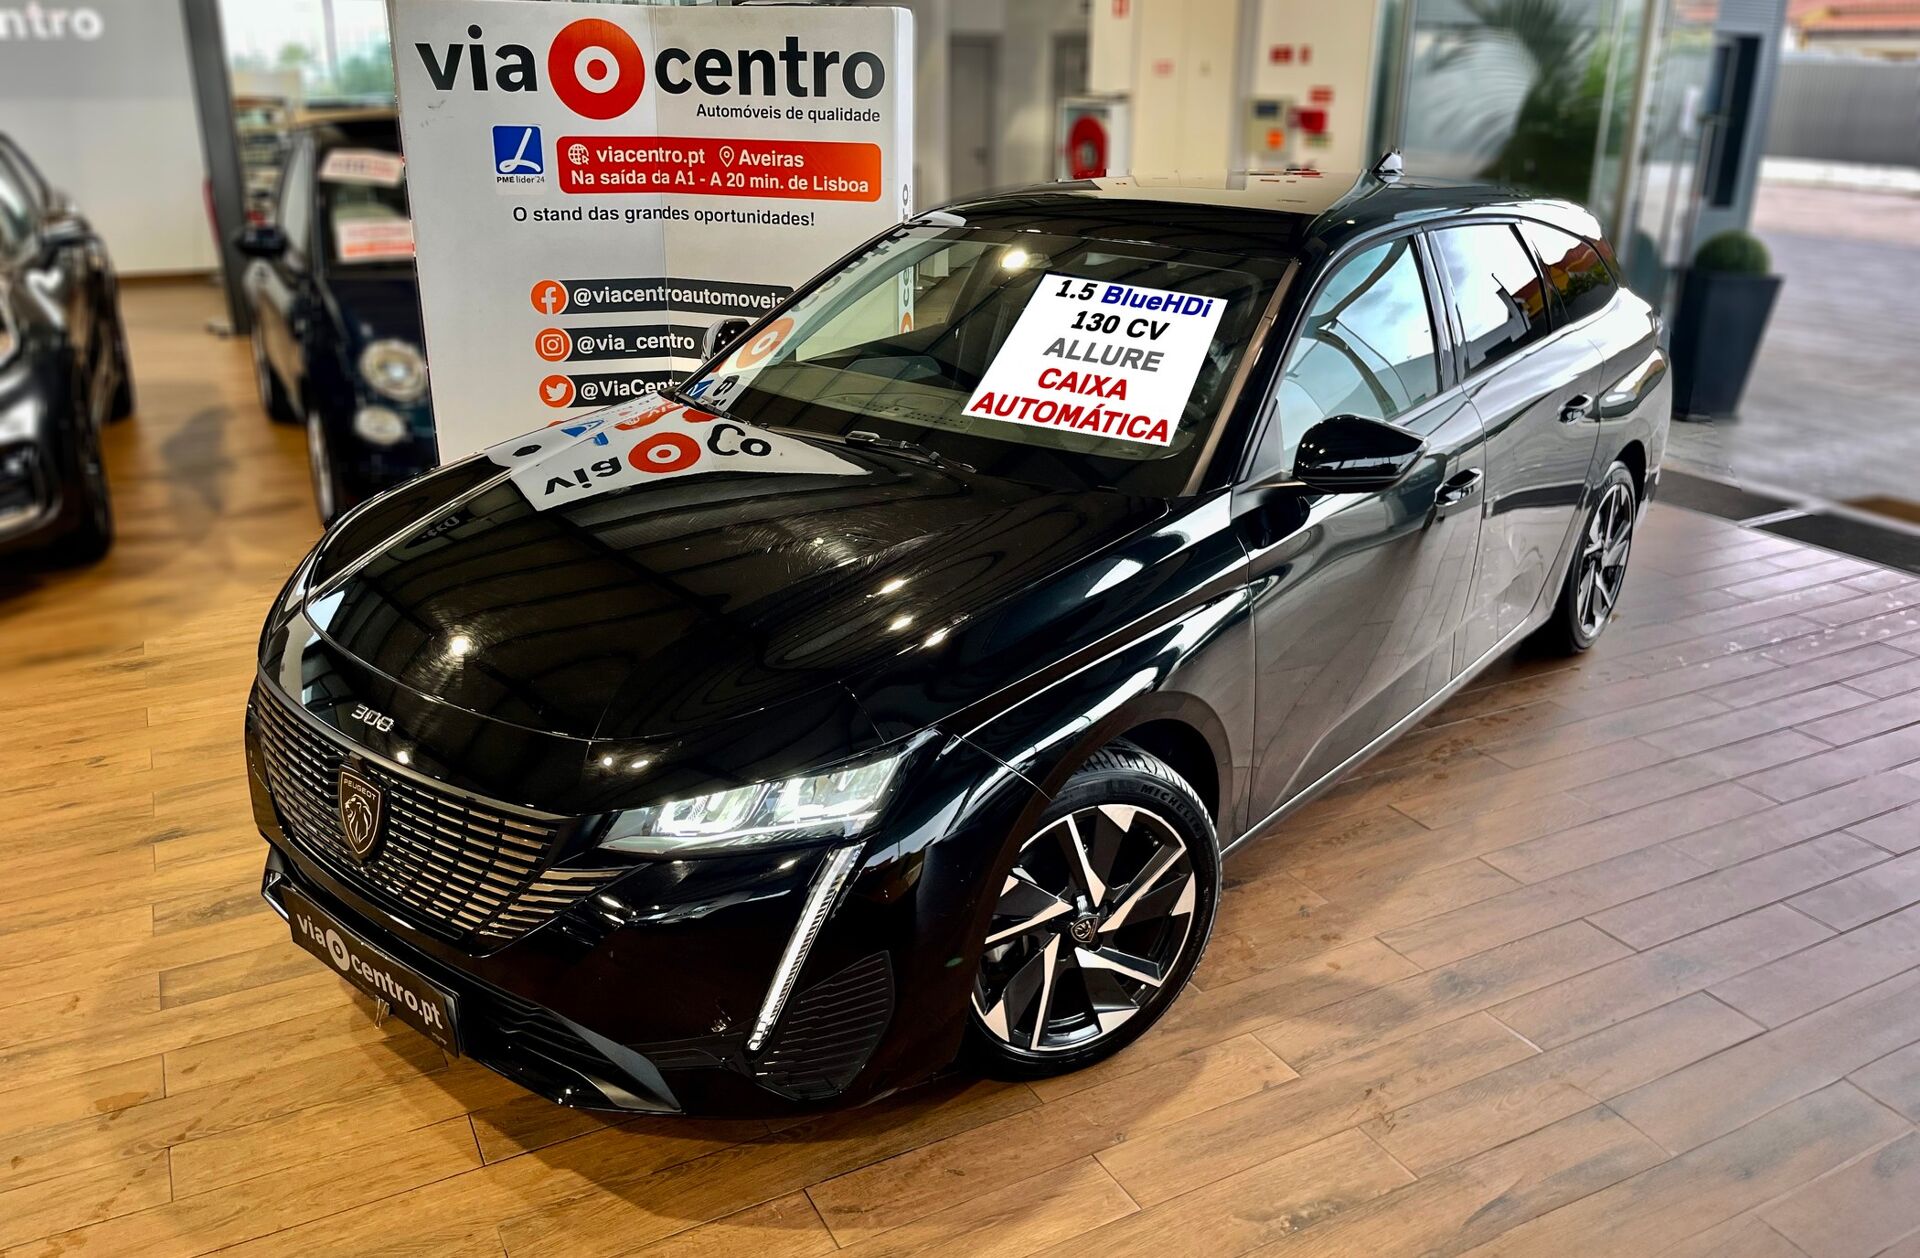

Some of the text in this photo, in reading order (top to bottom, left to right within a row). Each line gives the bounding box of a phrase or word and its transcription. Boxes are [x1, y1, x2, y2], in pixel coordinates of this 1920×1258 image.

[415, 24, 885, 99] via centro
[696, 104, 880, 123] Automóveis de qualidade
[596, 145, 705, 167] viacentro.pt
[738, 149, 804, 168] Aveiras
[571, 169, 595, 185] Na
[600, 169, 646, 185] saída
[652, 170, 670, 184] da
[675, 170, 695, 185] A1
[710, 172, 722, 187] A
[726, 172, 745, 188] 20
[750, 173, 784, 189] min.
[788, 175, 808, 190] de
[813, 175, 869, 193] Lisboa
[513, 205, 815, 226] O stand das grandes oportunidades!
[577, 332, 695, 354] @via_centro
[351, 703, 394, 732] 308
[343, 778, 376, 800] PEUGEOT
[296, 913, 443, 1030] via centro.pt
